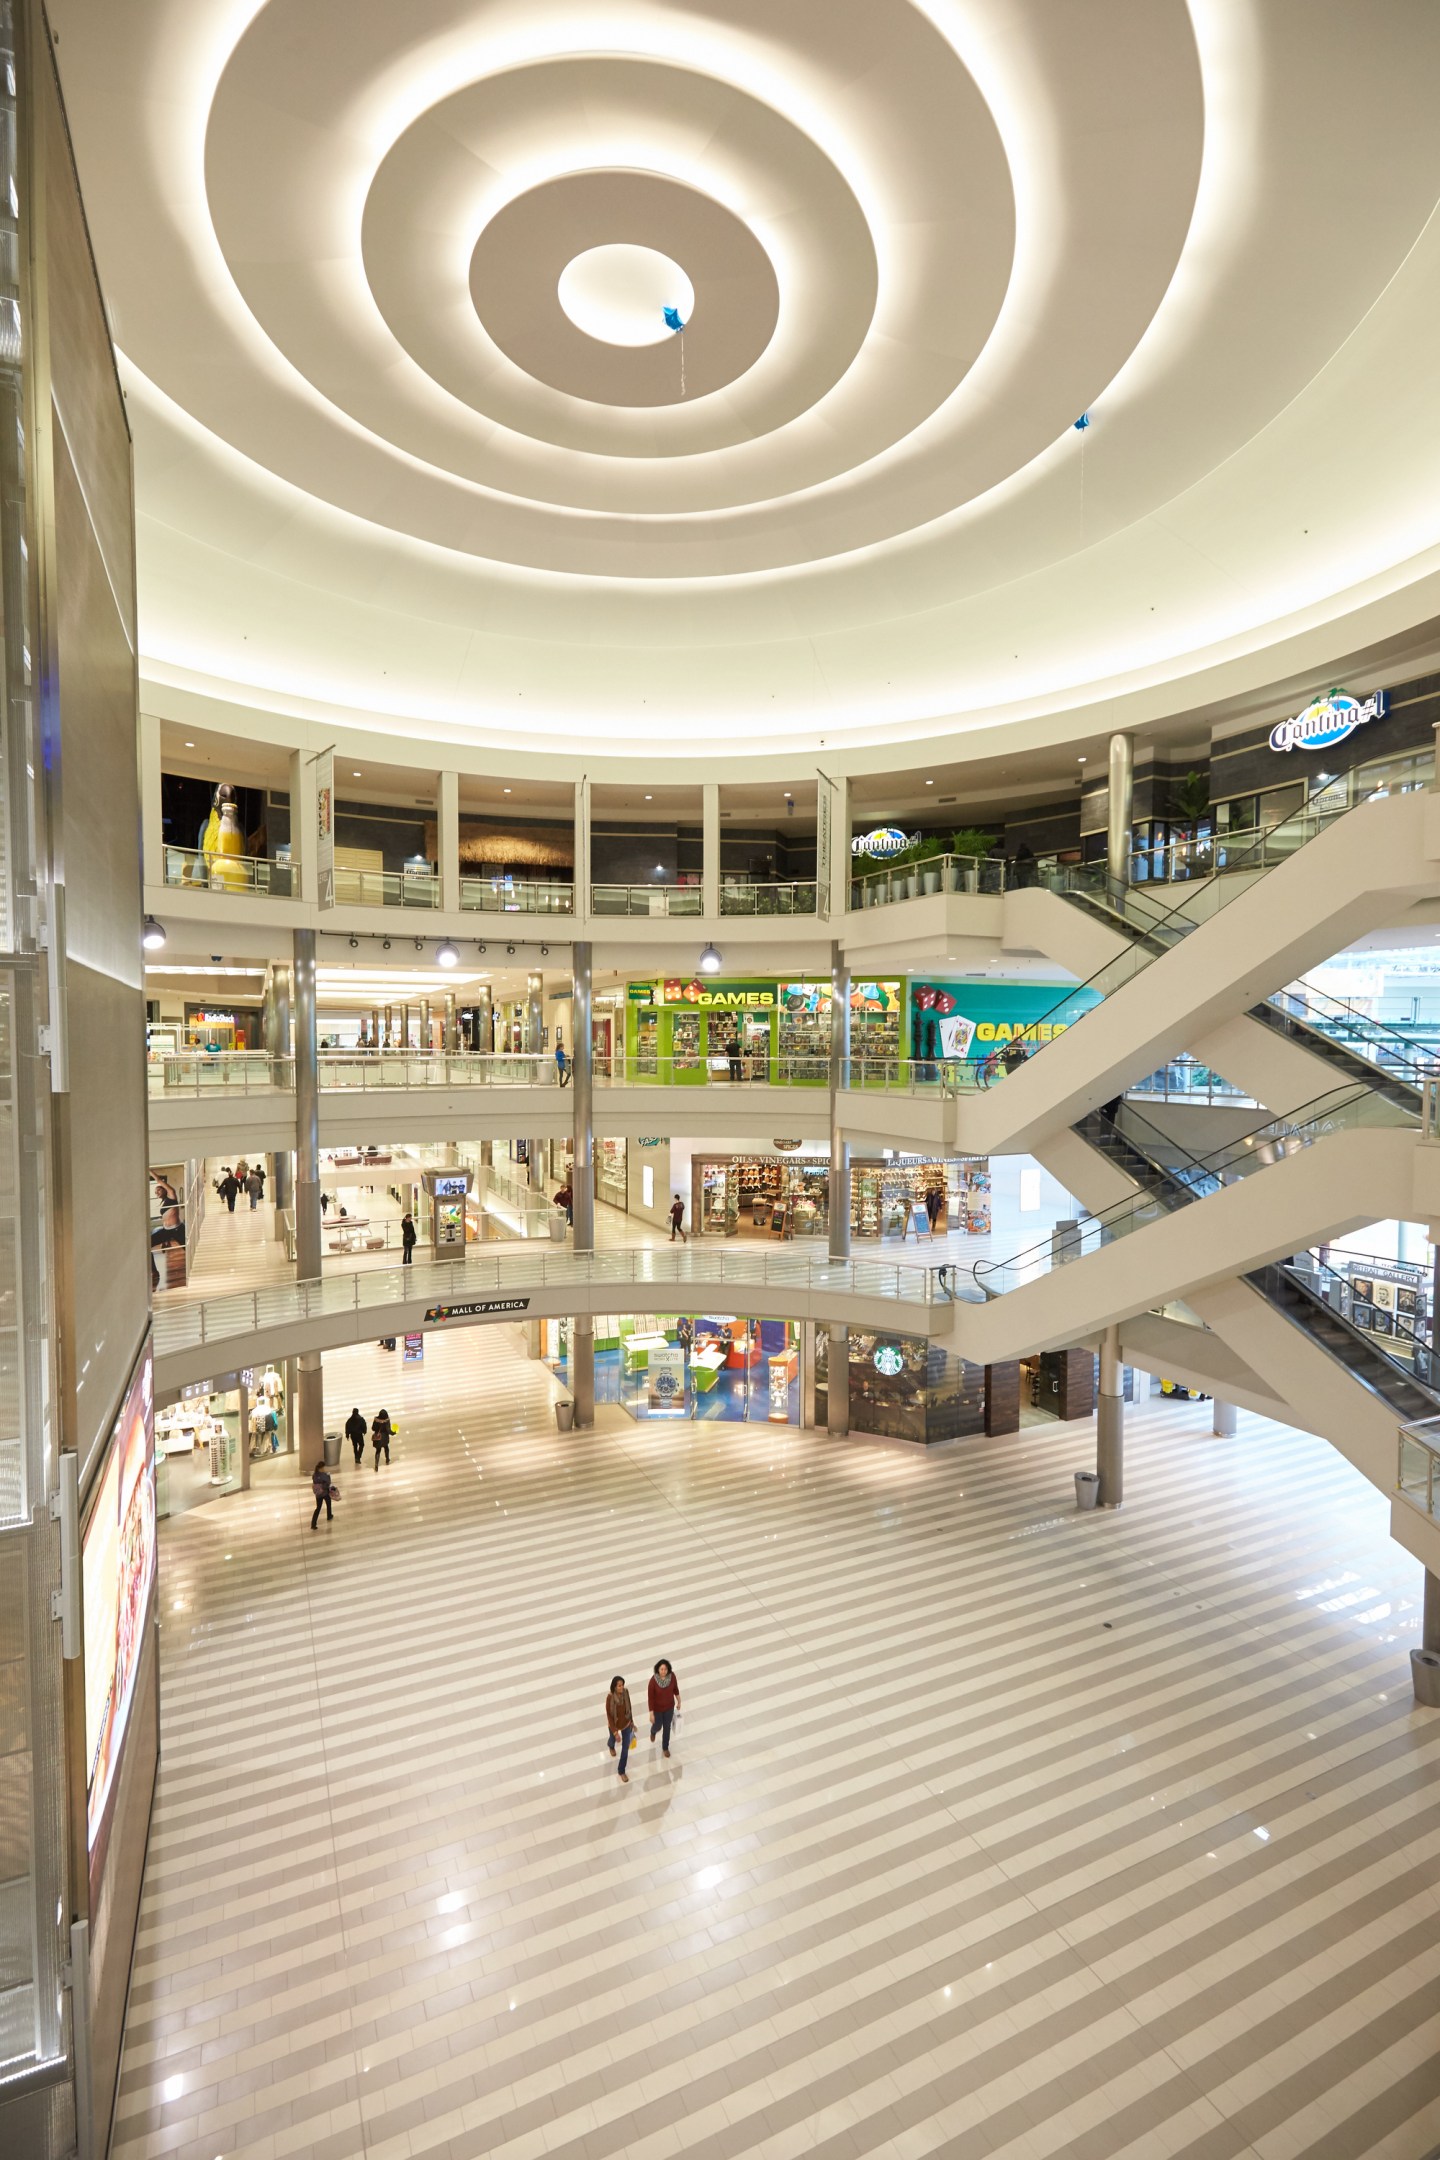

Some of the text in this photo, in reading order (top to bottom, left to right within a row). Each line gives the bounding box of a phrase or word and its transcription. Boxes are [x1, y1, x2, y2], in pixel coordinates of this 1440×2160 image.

[1270, 707, 1359, 750] Cantina
[325, 872, 334, 908] 4
[698, 992, 774, 1005] GAMES
[732, 1156, 753, 1164] OILS
[760, 1156, 806, 1165] VINEGARS
[887, 1156, 927, 1167] LIQUEURS
[1383, 1270, 1416, 1283] GALLERY
[451, 1301, 525, 1315] MALL OF AMERICA
